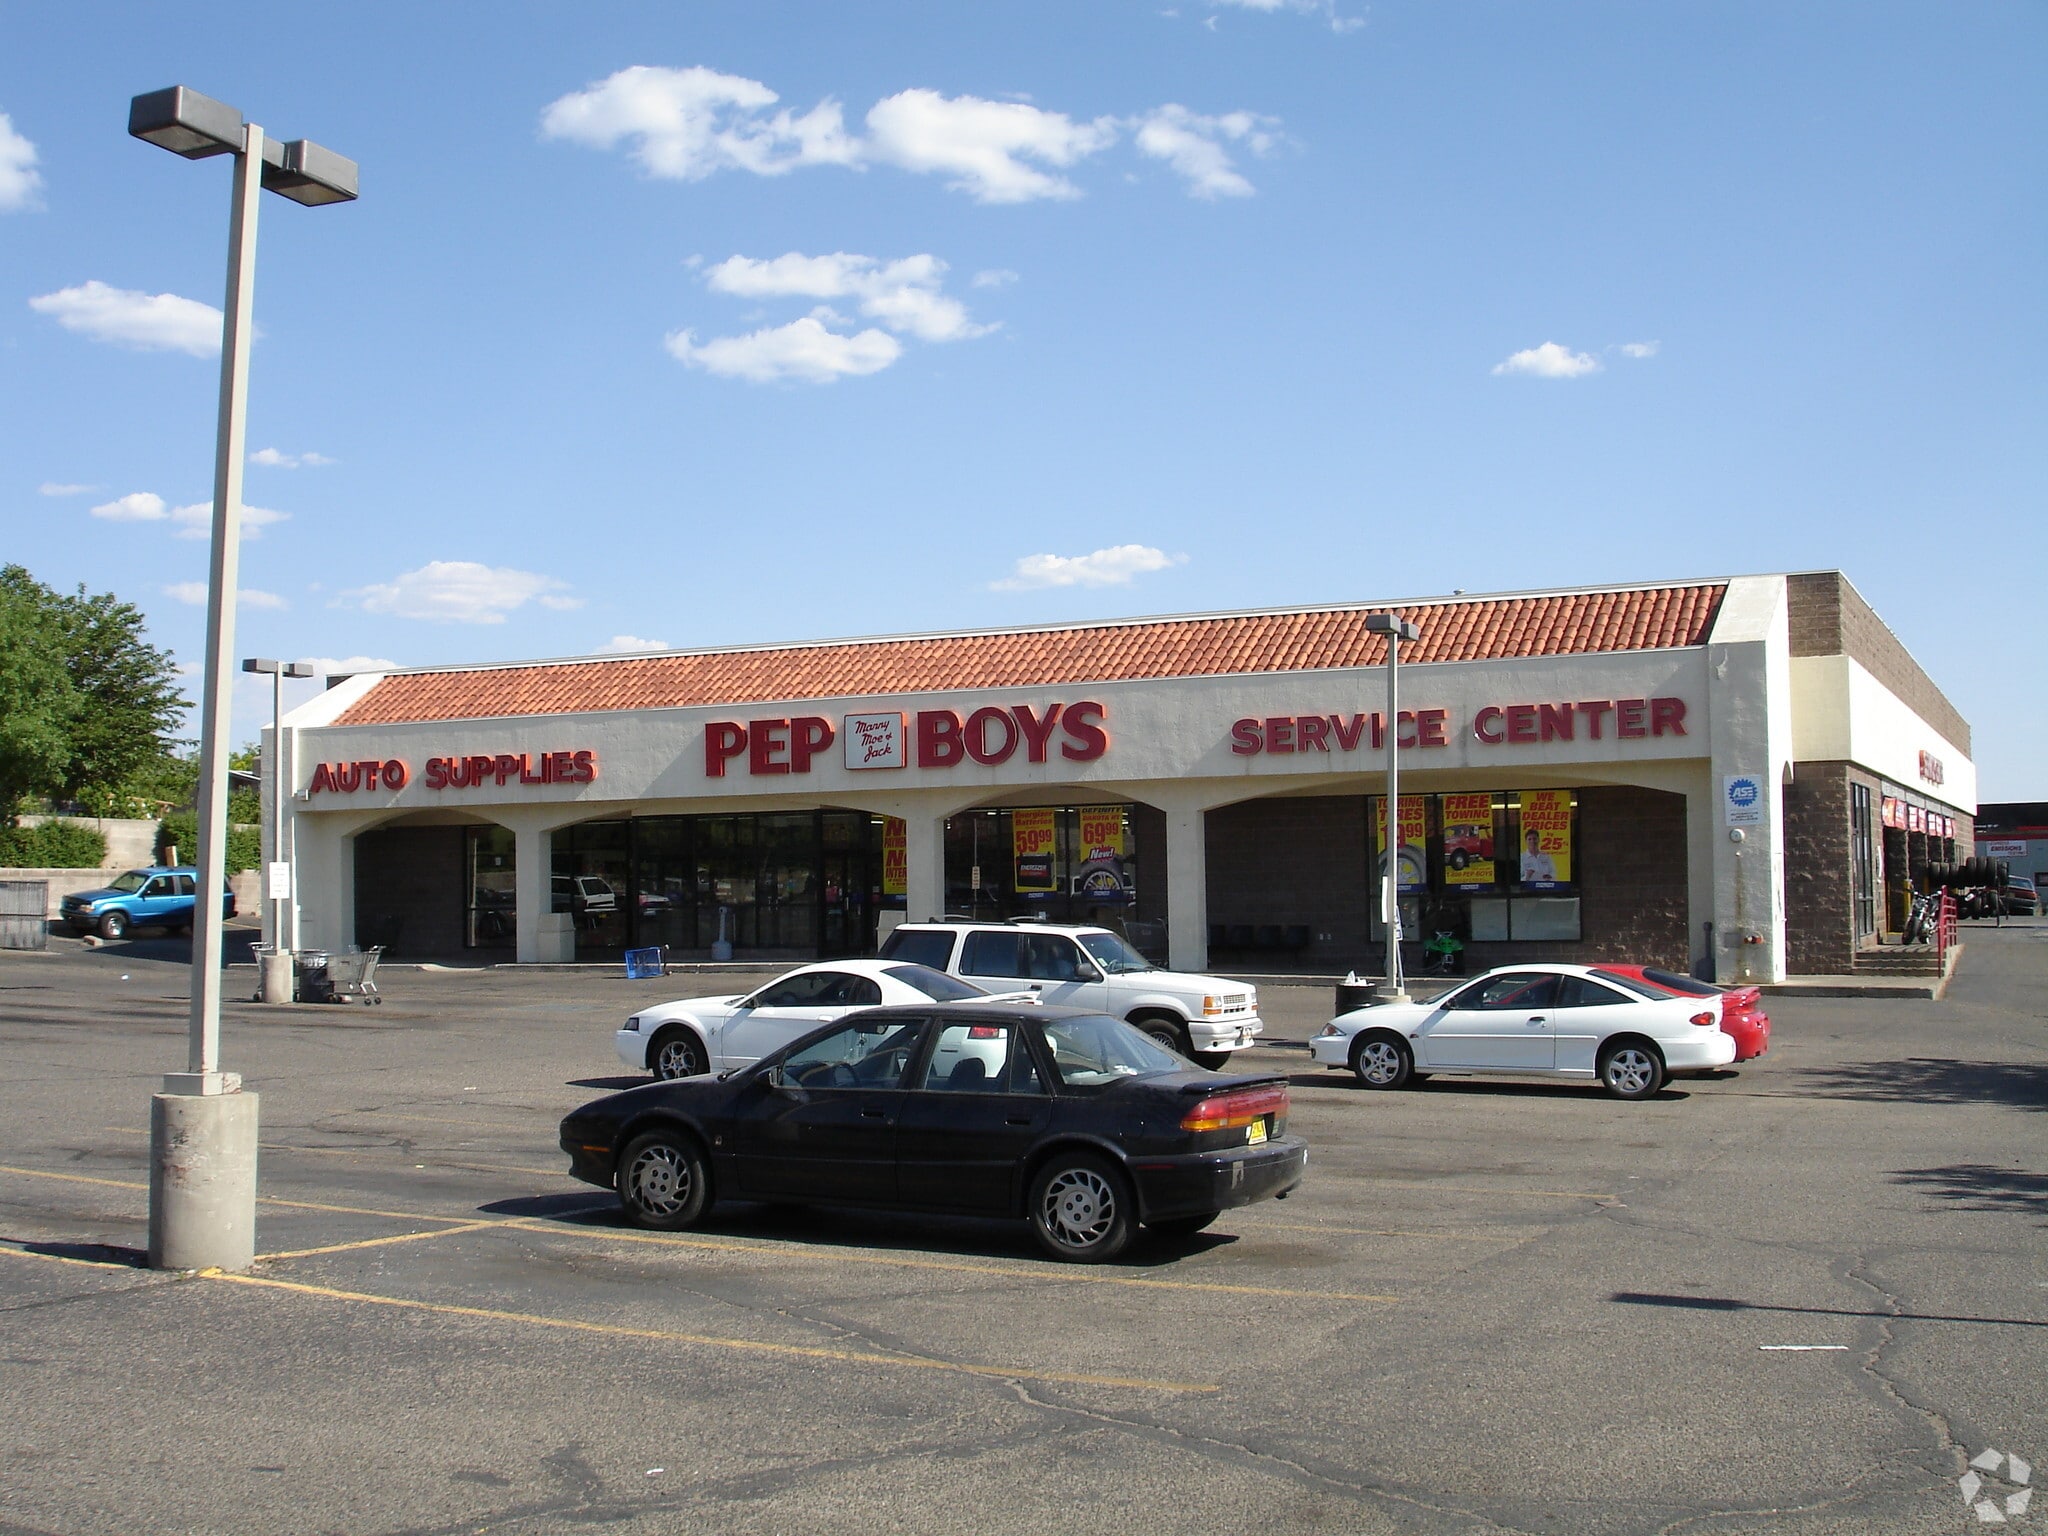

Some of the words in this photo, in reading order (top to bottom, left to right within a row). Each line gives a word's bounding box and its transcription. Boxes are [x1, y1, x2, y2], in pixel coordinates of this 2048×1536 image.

[855, 720, 890, 734] Manny
[1230, 708, 1449, 756] SERVICE
[1474, 696, 1688, 744] CENTER
[705, 717, 835, 777] PEP
[917, 701, 1110, 768] BOYS
[861, 733, 884, 746] Moe
[864, 742, 892, 763] Jack
[310, 758, 410, 794] AUTO
[425, 750, 599, 789] SUPPLIES
[1536, 791, 1556, 801] WE
[1733, 786, 1753, 798] ASE
[1377, 797, 1423, 808] TORING
[1445, 795, 1490, 810] FREE
[1530, 802, 1561, 811] BEAT
[1379, 808, 1423, 821] TRES
[1445, 809, 1490, 820] TOWING
[1522, 811, 1569, 821] DEALER
[886, 816, 906, 836] N
[1523, 821, 1568, 831] PRICES
[886, 850, 906, 867] N
